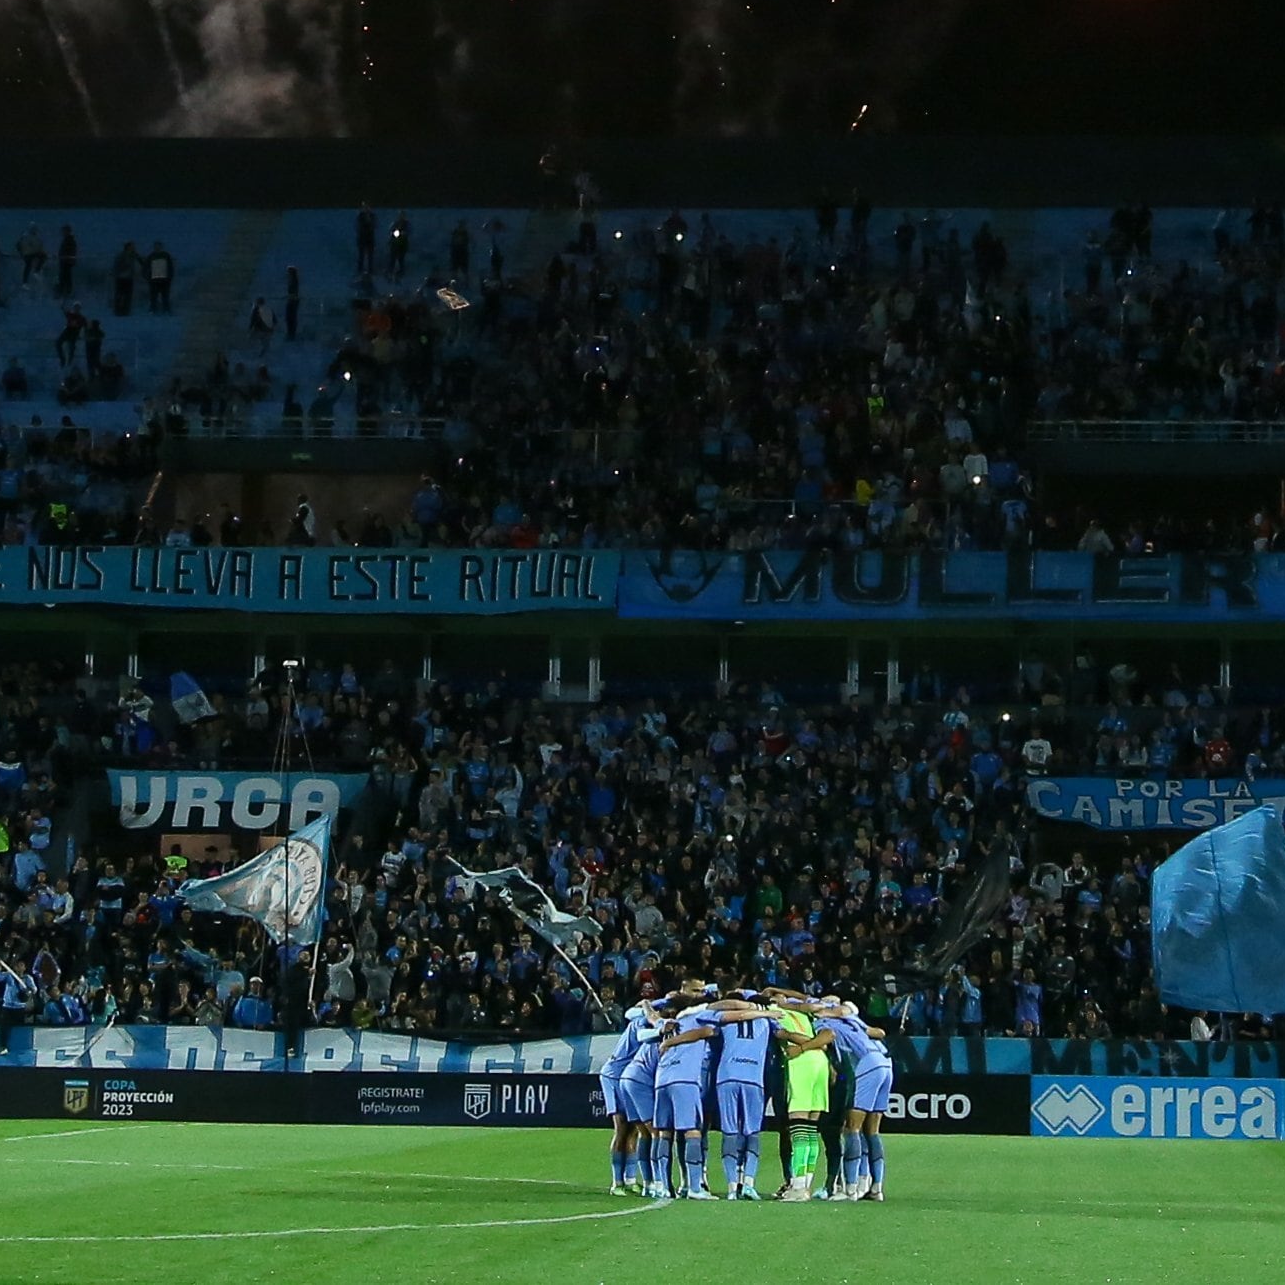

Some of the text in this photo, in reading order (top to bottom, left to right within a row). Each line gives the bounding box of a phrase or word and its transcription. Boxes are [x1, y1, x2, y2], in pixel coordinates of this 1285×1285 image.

[28, 545, 106, 591] NOS
[131, 547, 254, 599] LLEVA
[278, 555, 305, 601] A
[329, 555, 433, 601] ESTE
[459, 552, 603, 601] RITUAL
[1115, 779, 1252, 798] POR LA
[117, 776, 340, 830] URCA
[103, 1080, 136, 1091] COPA
[357, 1087, 425, 1100] ¡REGISTRATE!
[102, 1089, 174, 1104] PROYECCIÓN
[501, 1084, 550, 1115] PLAY
[883, 1092, 972, 1120] acro
[102, 1104, 134, 1116] 2023
[360, 1102, 420, 1116] lpfplay.com
[1110, 1083, 1277, 1138] errea
